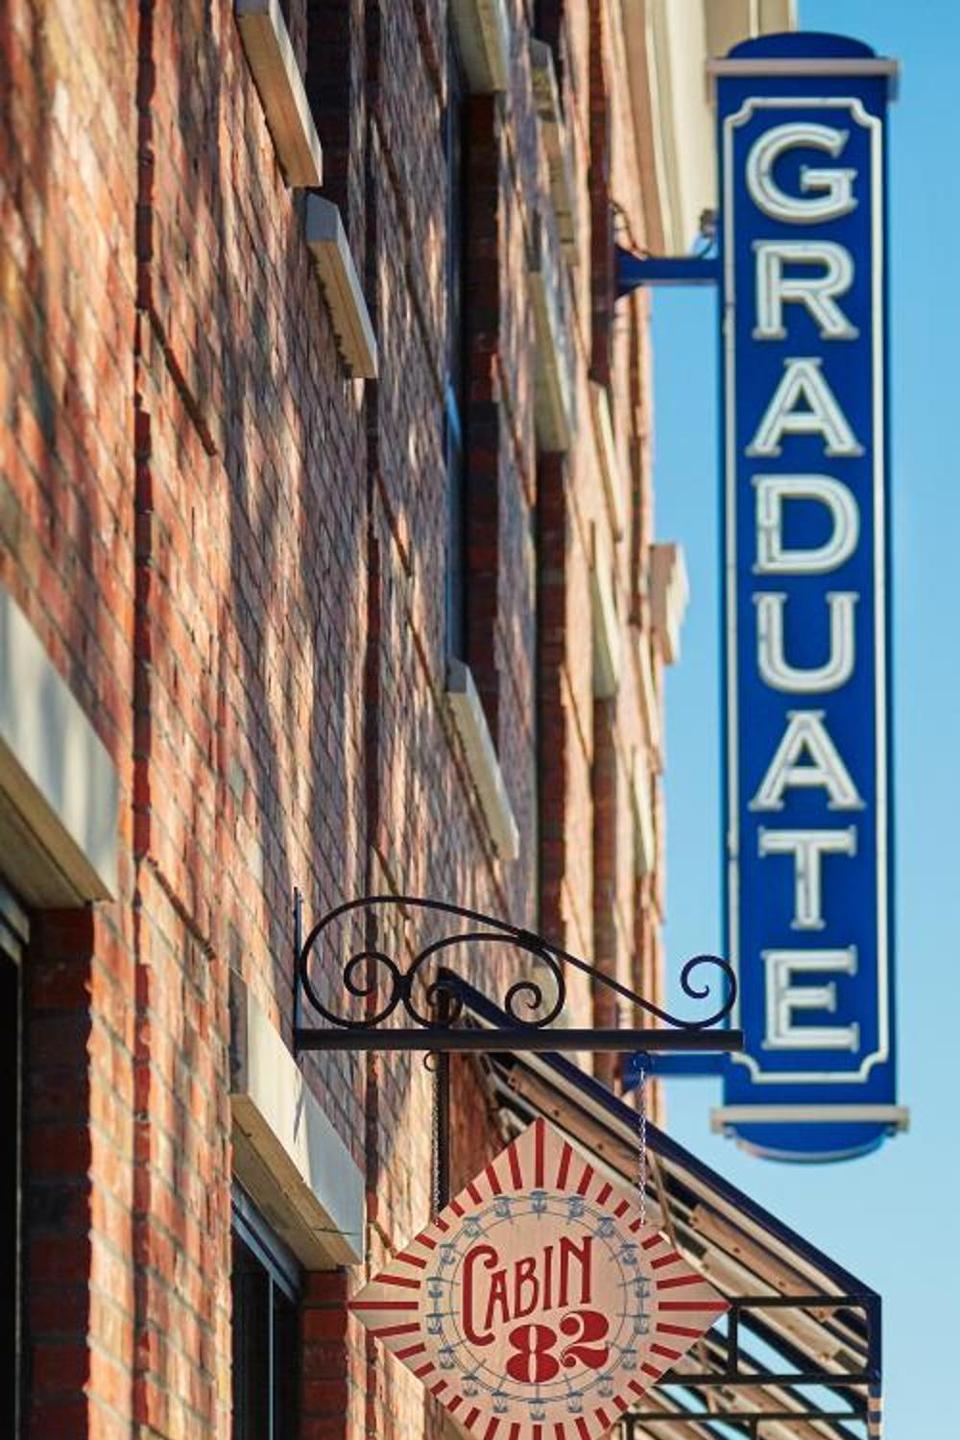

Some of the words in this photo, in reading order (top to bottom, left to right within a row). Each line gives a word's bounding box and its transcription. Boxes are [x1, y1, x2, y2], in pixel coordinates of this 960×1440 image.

[745, 122, 865, 1053] GRADUATE
[462, 1236, 593, 1346] CABIN
[506, 1310, 609, 1383] 82
